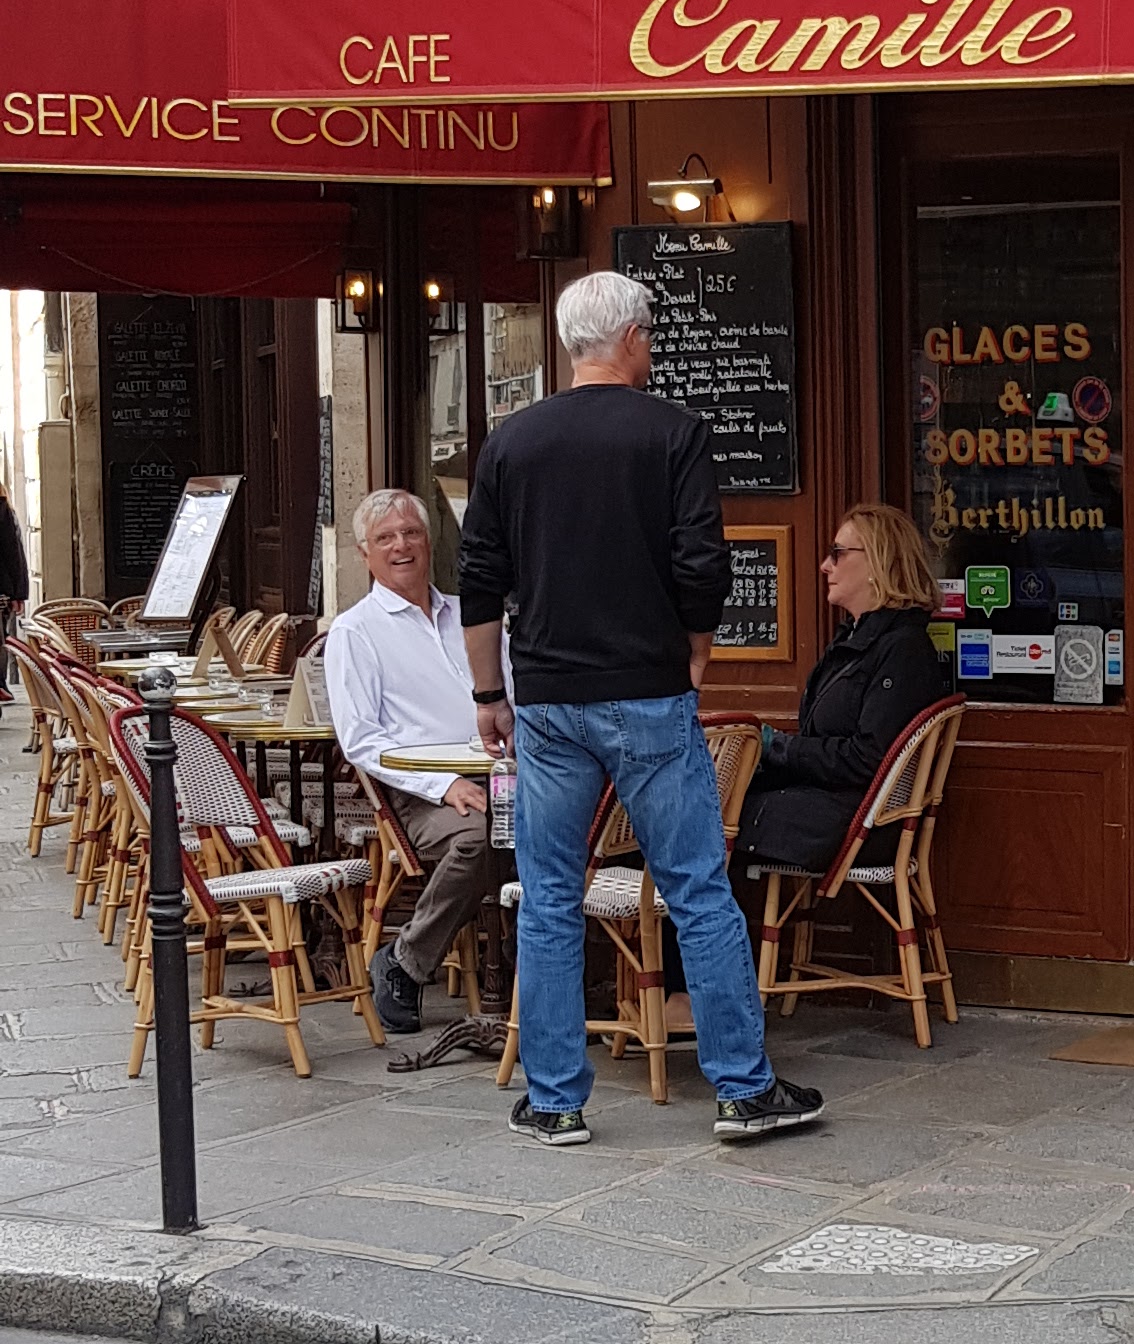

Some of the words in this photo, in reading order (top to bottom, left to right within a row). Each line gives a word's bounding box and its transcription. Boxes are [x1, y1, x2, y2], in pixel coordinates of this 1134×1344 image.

[339, 33, 451, 85] CAFE
[2, 92, 241, 142] SERVICE
[270, 103, 521, 152] CONTINU
[656, 233, 688, 255] Menu
[689, 233, 732, 252] Camille
[661, 290, 697, 307] Dessert
[706, 274, 737, 293] 25€
[924, 321, 1092, 365] GLACES
[998, 379, 1031, 416] &
[925, 426, 1110, 466] SORBETS
